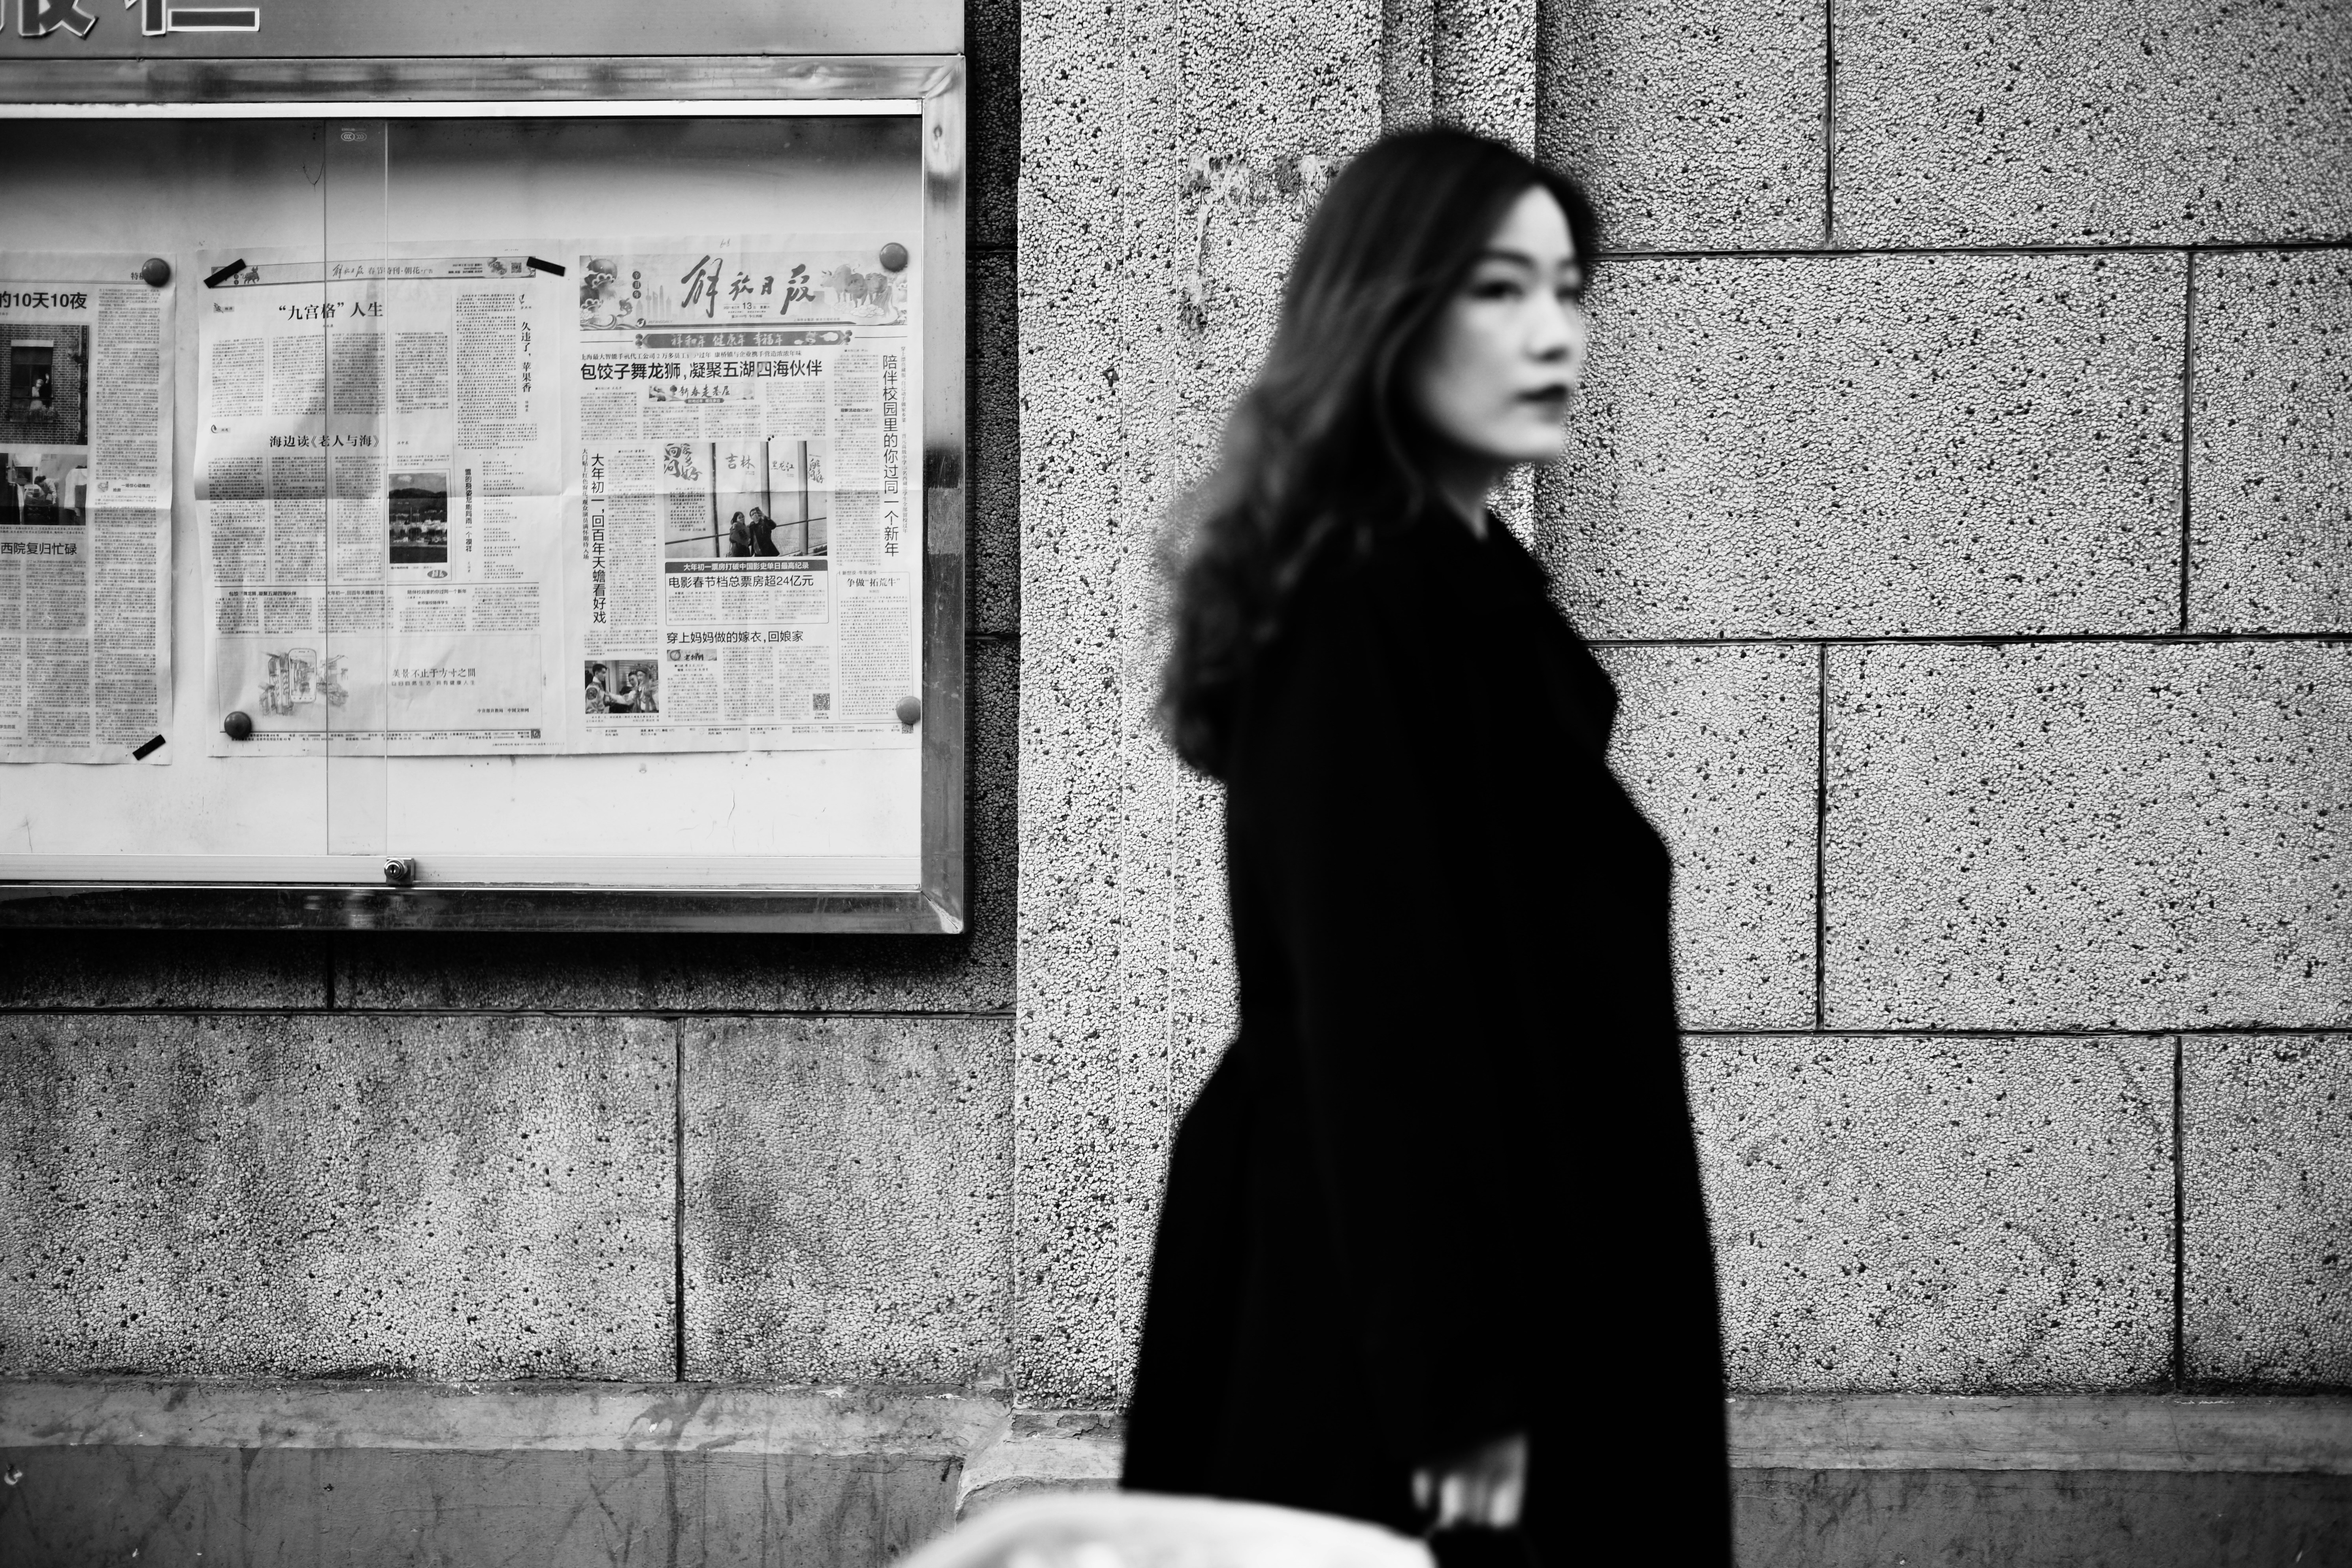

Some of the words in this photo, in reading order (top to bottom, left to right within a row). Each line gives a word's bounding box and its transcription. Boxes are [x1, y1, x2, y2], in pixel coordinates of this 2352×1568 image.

[681, 255, 816, 318] 解放日报
[0, 291, 87, 309] 的10天10夜
[679, 384, 730, 398] 新春走基层
[270, 435, 380, 448] 海边读《老人与海》
[726, 453, 755, 469] 吉林
[883, 354, 899, 556] 陪伴校园里的你过同一个新年
[771, 460, 794, 471] 黑龙江
[591, 453, 606, 624] 大年初一，回百年天蟾看好戏
[0, 542, 77, 555] 西院复归忙碌
[683, 562, 809, 571] 大年初一票房打破中国影史单日最高纪录
[669, 575, 814, 588] 电影春节档总票房超24亿元
[667, 630, 804, 644] 穿上妈妈做的嫁衣，回娘家
